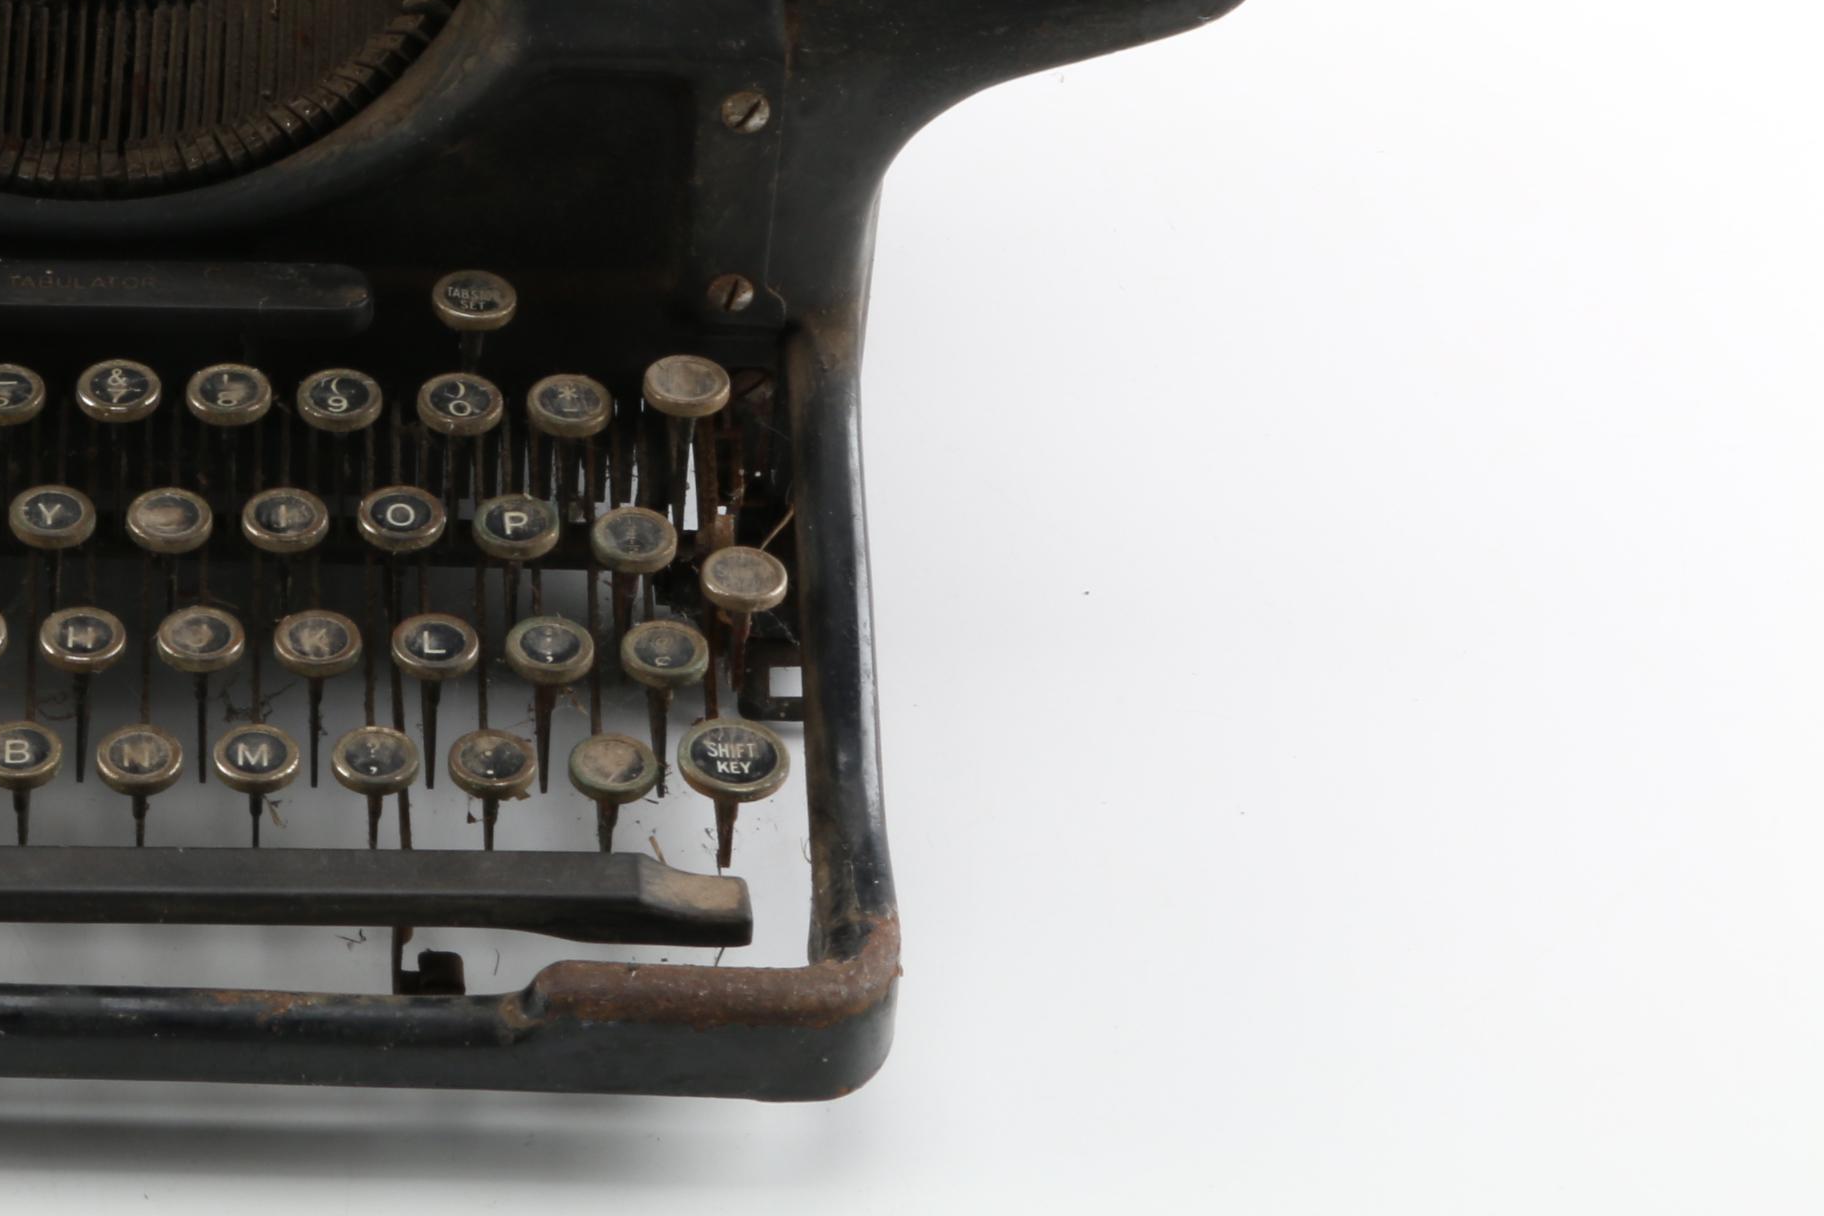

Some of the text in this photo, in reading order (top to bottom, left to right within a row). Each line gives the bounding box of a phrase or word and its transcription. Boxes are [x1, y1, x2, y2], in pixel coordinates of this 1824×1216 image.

[8, 272, 160, 290] TABULATOR
[216, 390, 238, 407] 8
[326, 395, 349, 414] 9
[37, 501, 63, 526] Y
[385, 501, 417, 527] O
[501, 509, 527, 536] P
[66, 625, 94, 649] H
[422, 630, 447, 654] L
[3, 738, 33, 764] B
[122, 742, 151, 769] N
[236, 741, 270, 768] M
[704, 740, 757, 759] SHIFT
[716, 759, 753, 775] KEY
